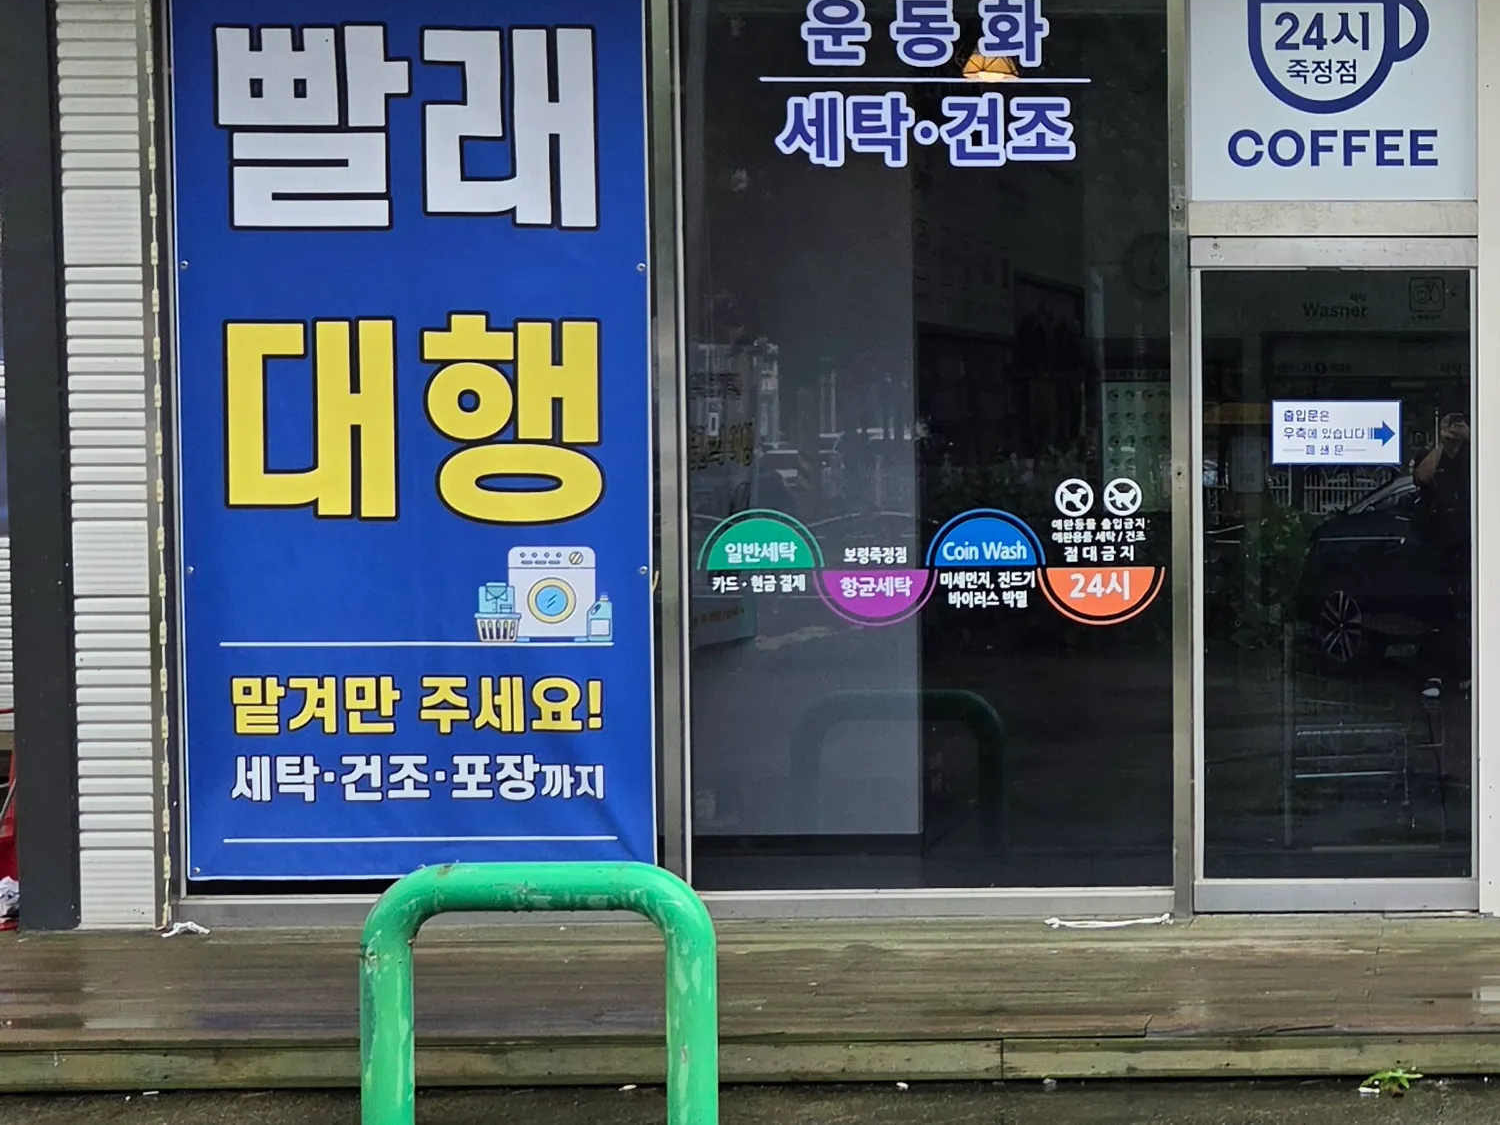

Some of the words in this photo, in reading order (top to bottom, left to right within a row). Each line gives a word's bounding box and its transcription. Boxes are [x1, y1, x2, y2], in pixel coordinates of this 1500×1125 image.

[1274, 11, 1370, 51] 24시
[1286, 58, 1358, 85] 죽정점
[213, 22, 602, 230] 빨래
[1227, 128, 1439, 167] COFFEE
[222, 310, 606, 524] 대행
[1321, 427, 1366, 440] 있습니다
[724, 541, 798, 564] 일반세탁
[843, 546, 908, 564] 보령죽정점
[942, 540, 978, 561] Coin
[981, 539, 1028, 561] Wash
[712, 575, 740, 594] 카드
[751, 574, 777, 593] 현금
[779, 574, 806, 593] 결제
[840, 576, 914, 598] 항균세탁
[997, 570, 1036, 589] 진드기
[1069, 569, 1131, 601] 24시
[948, 590, 1000, 609] 바이러스
[1002, 589, 1029, 608] 박멸
[230, 675, 402, 735] 맡겨만
[418, 675, 604, 735] 주세요!
